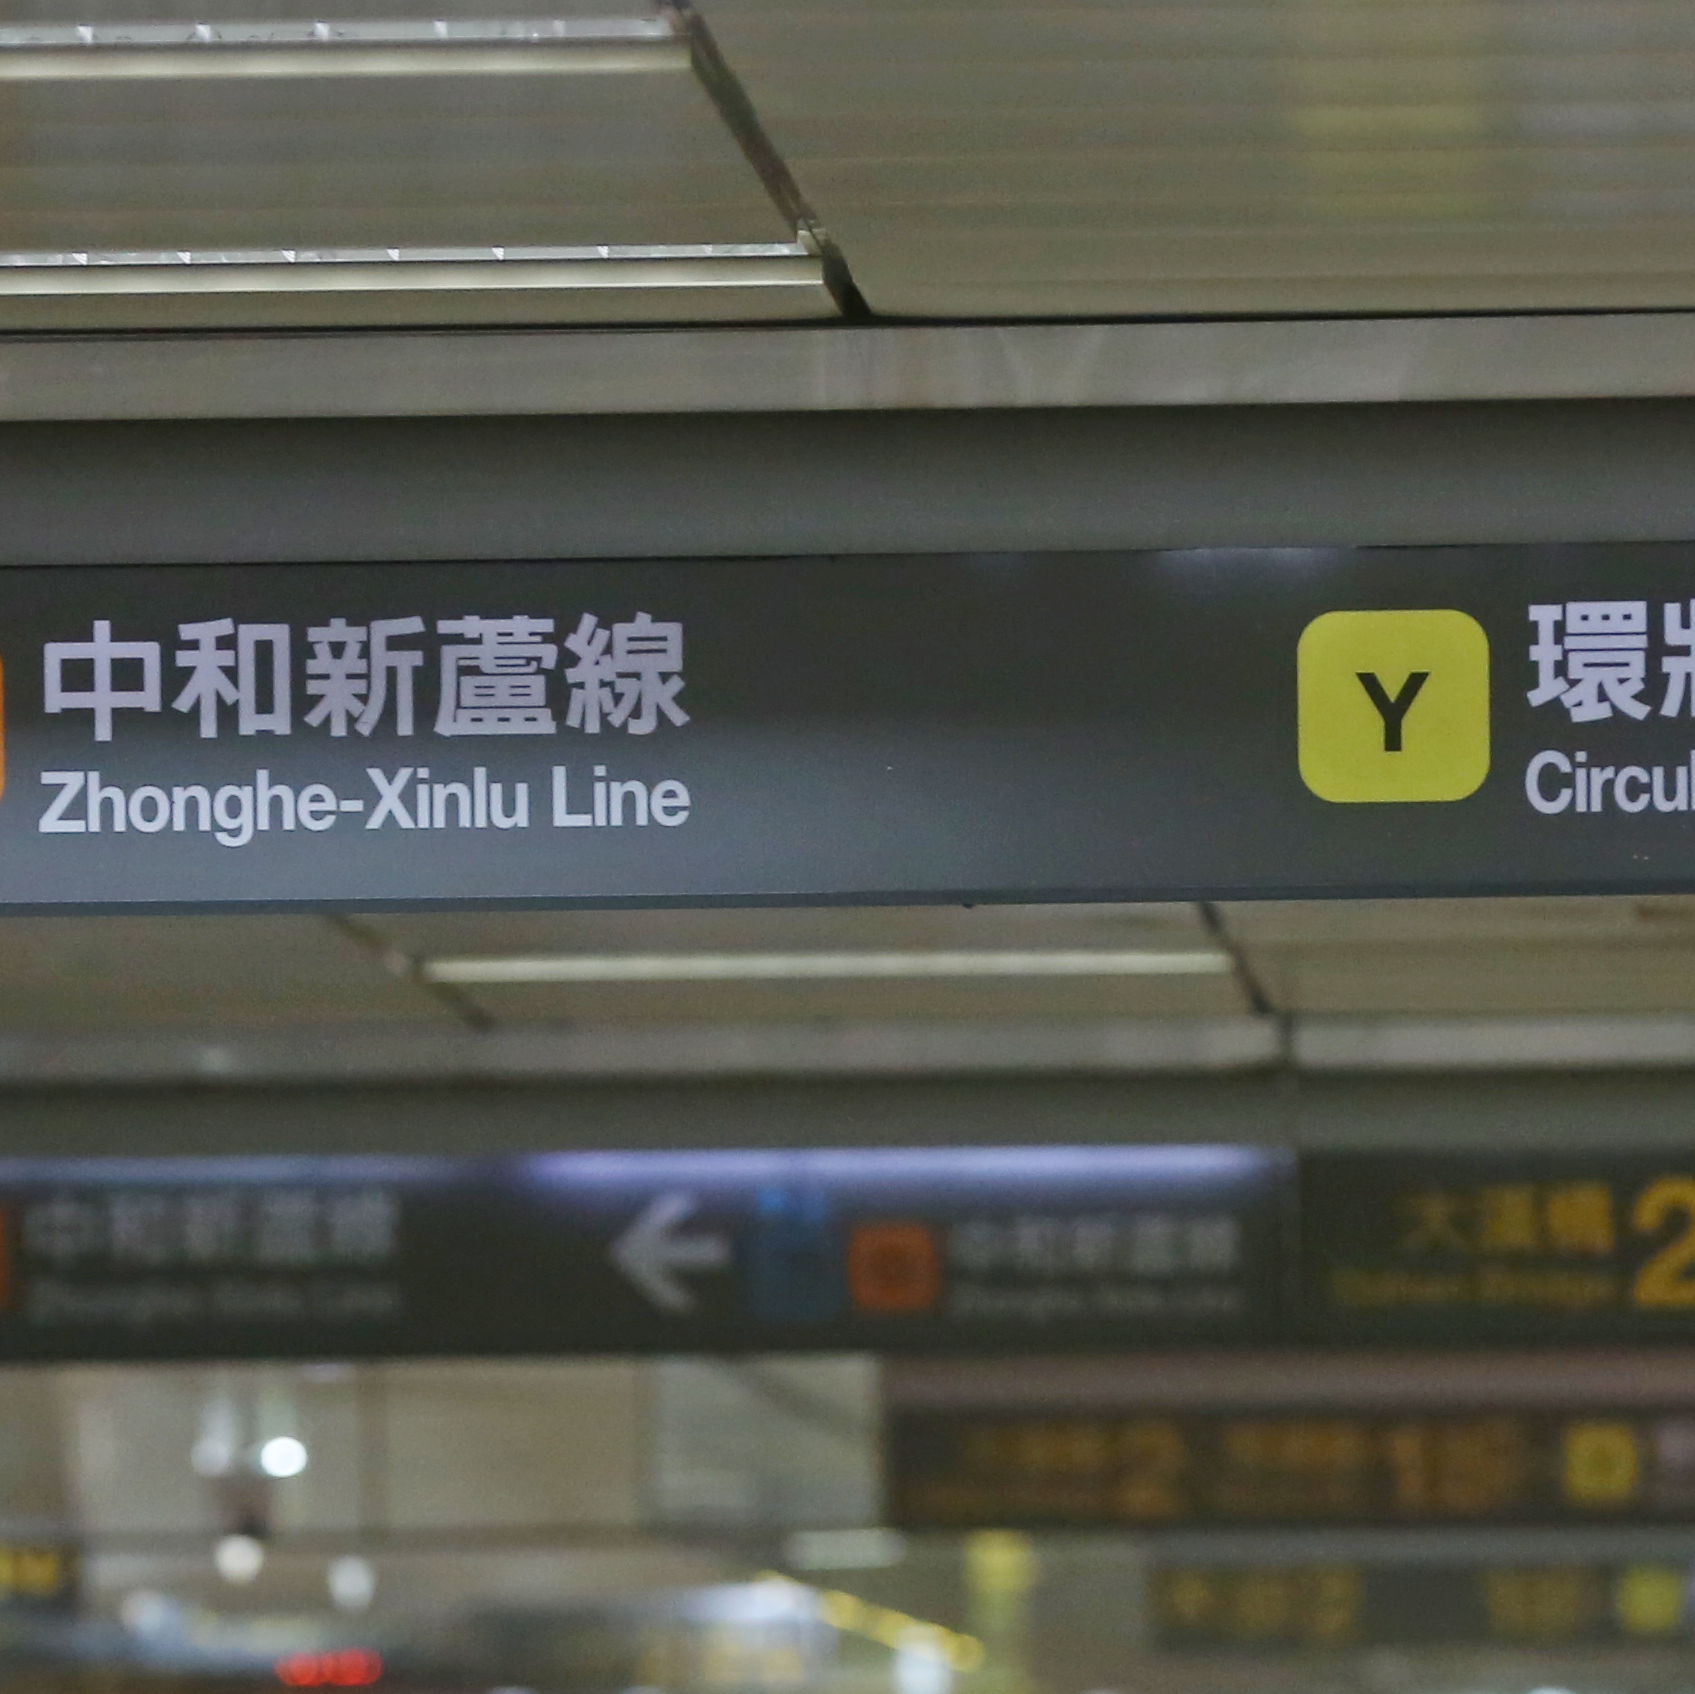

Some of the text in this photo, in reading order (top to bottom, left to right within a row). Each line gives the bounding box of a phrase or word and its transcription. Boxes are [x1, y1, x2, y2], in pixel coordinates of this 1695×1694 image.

[41, 611, 690, 742] 中和新蘆線
[1353, 669, 1433, 755] Y
[37, 764, 692, 849] Zhonghe-Xinlu Line
